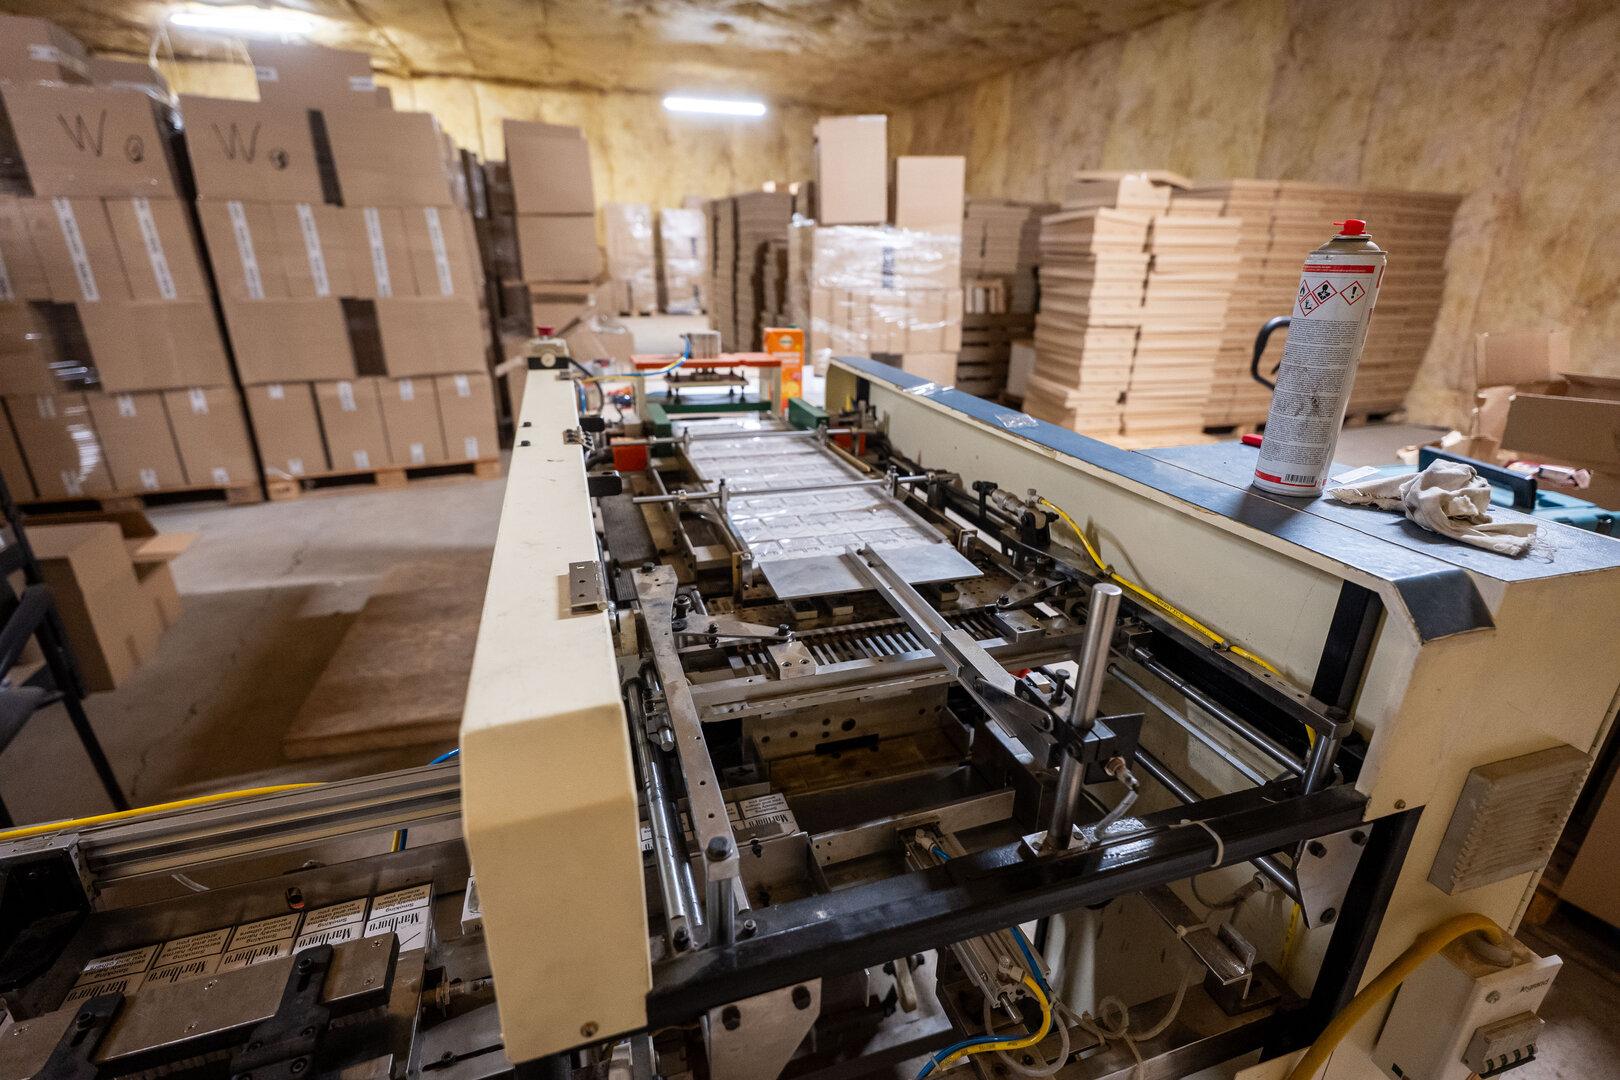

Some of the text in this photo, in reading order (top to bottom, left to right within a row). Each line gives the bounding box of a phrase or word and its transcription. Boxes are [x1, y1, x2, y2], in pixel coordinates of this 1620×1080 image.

[369, 912, 420, 932] Marlboro
[299, 928, 352, 947] Marlboro
[224, 944, 280, 966] Marlboro
[148, 960, 207, 983] Marlboro
